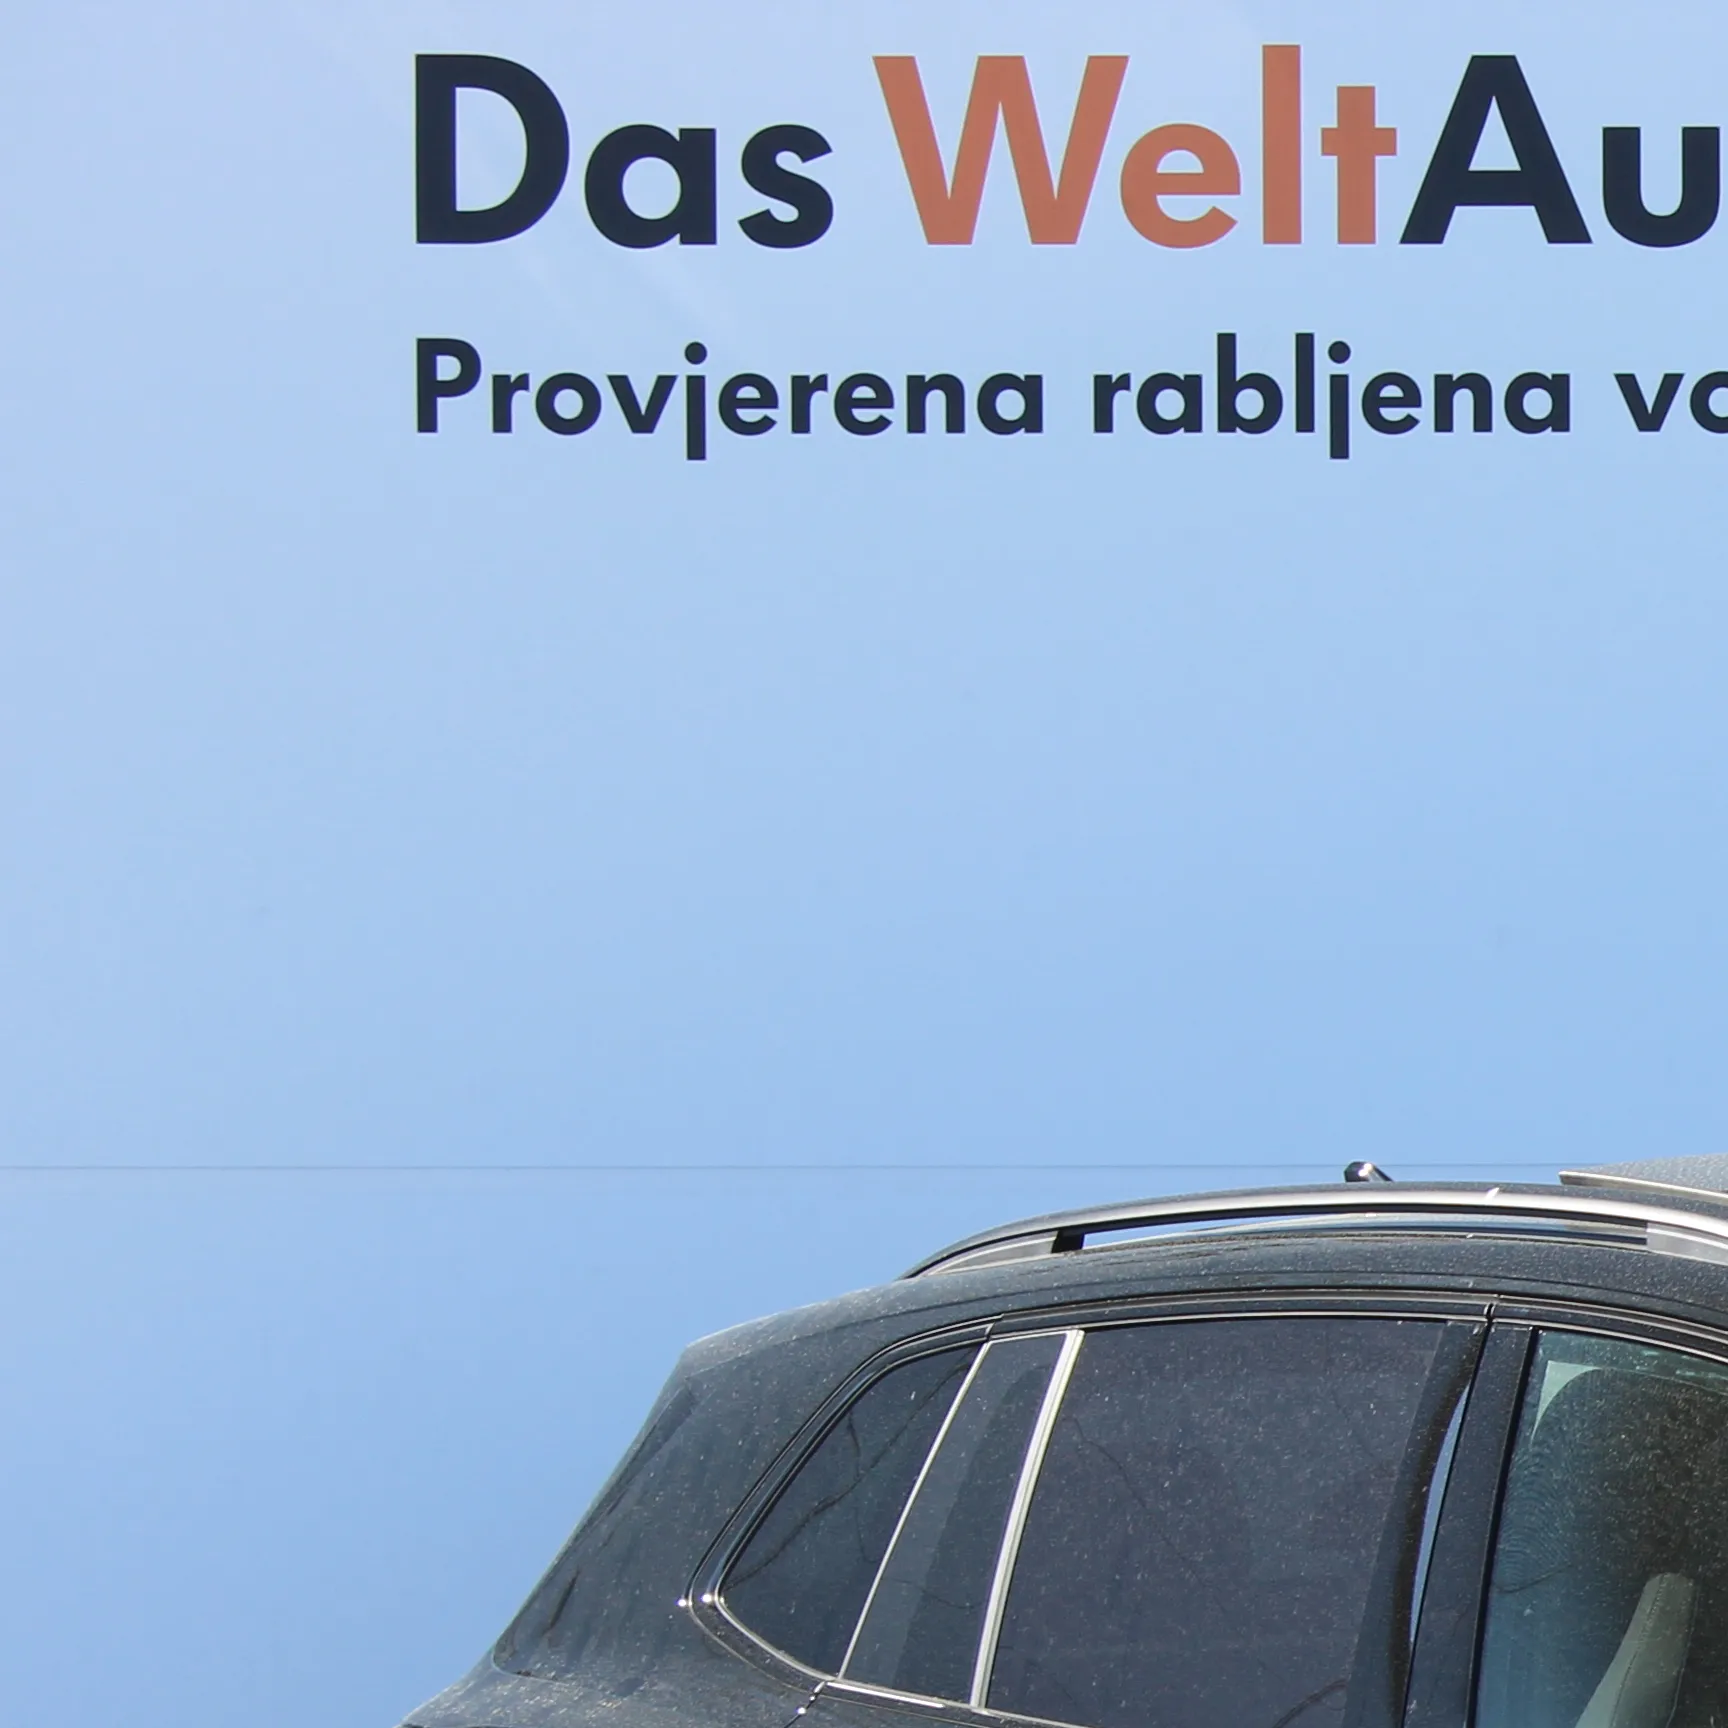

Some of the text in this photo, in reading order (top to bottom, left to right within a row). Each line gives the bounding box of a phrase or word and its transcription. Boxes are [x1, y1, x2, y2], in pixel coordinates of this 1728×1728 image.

[414, 53, 833, 249] Das
[416, 337, 1043, 461] Provjerena
[1093, 332, 1570, 461] rabljena
